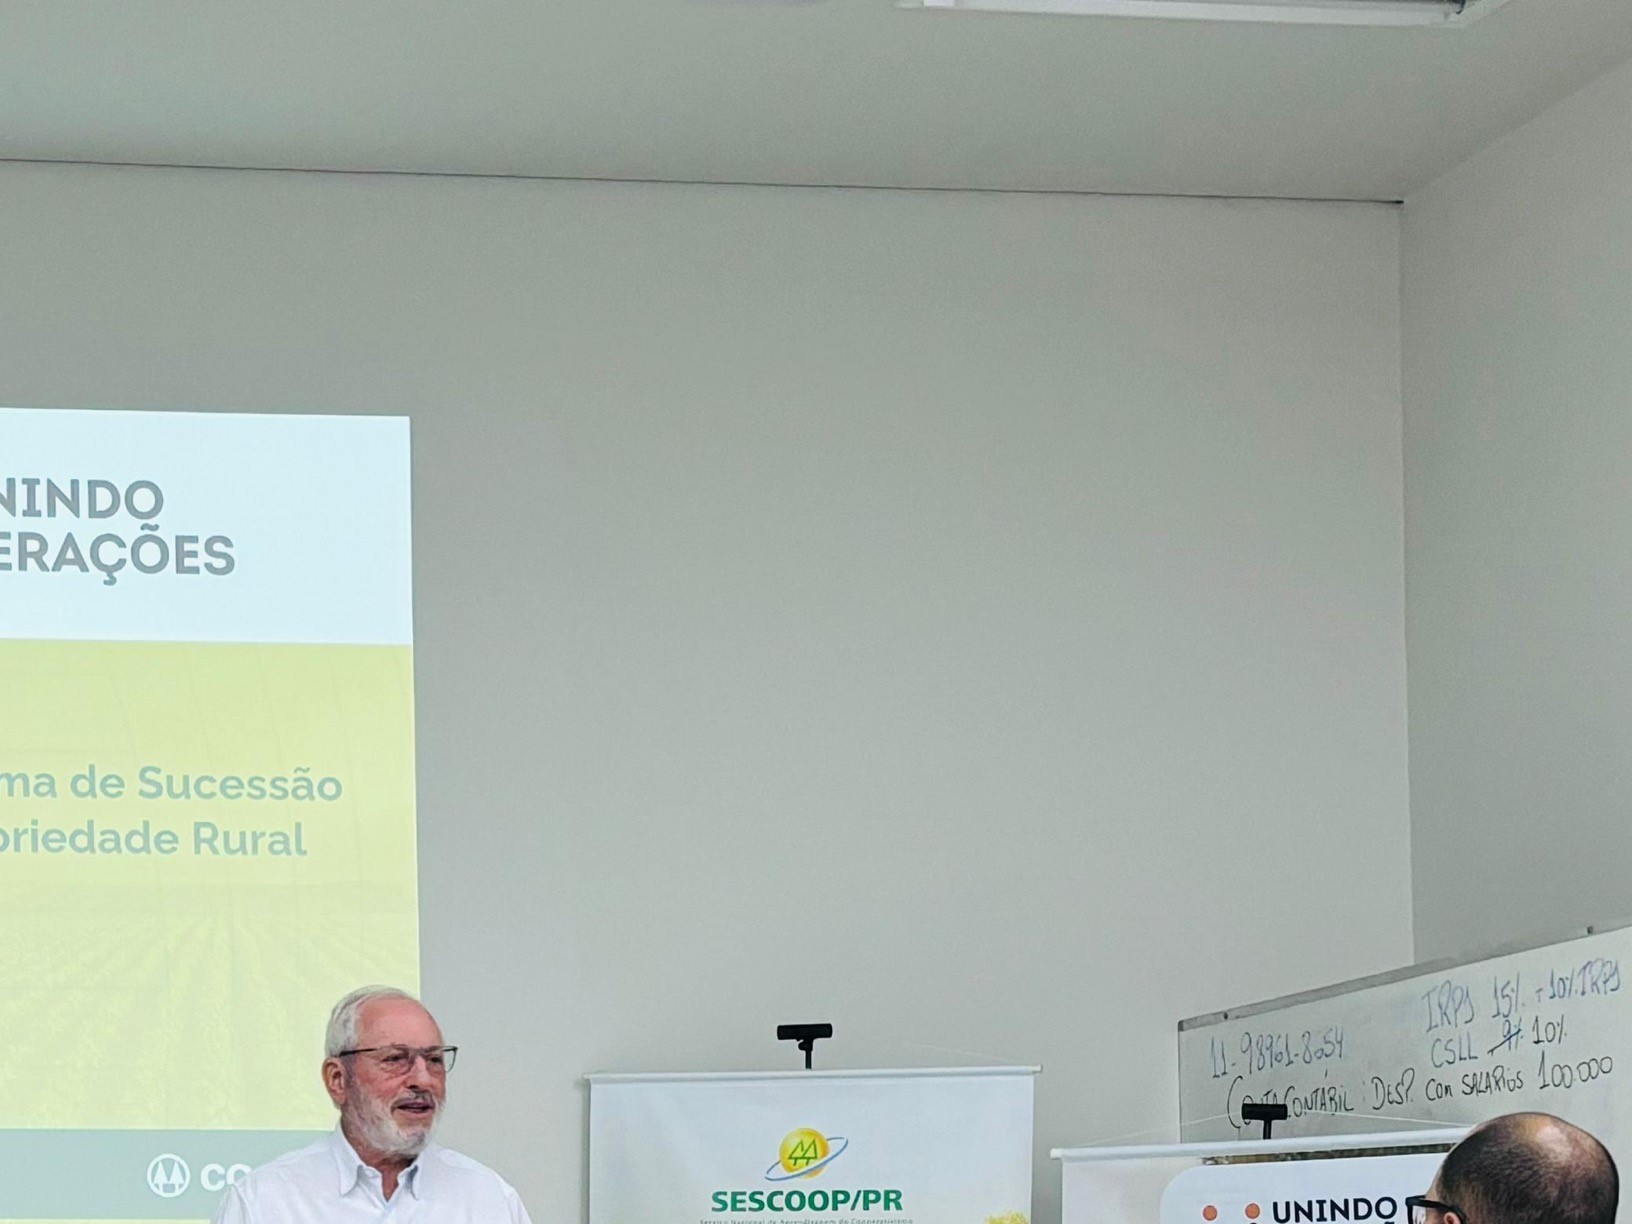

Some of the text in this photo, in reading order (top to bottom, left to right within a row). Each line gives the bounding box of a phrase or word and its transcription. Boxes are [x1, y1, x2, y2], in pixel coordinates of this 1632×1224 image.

[69, 764, 126, 799] de
[138, 766, 343, 801] Sucessão
[193, 821, 308, 856] Rural
[1430, 1032, 1479, 1069] CSLL
[710, 1189, 903, 1212] SESCOOP/PR
[1272, 1196, 1397, 1224] UNINDO
